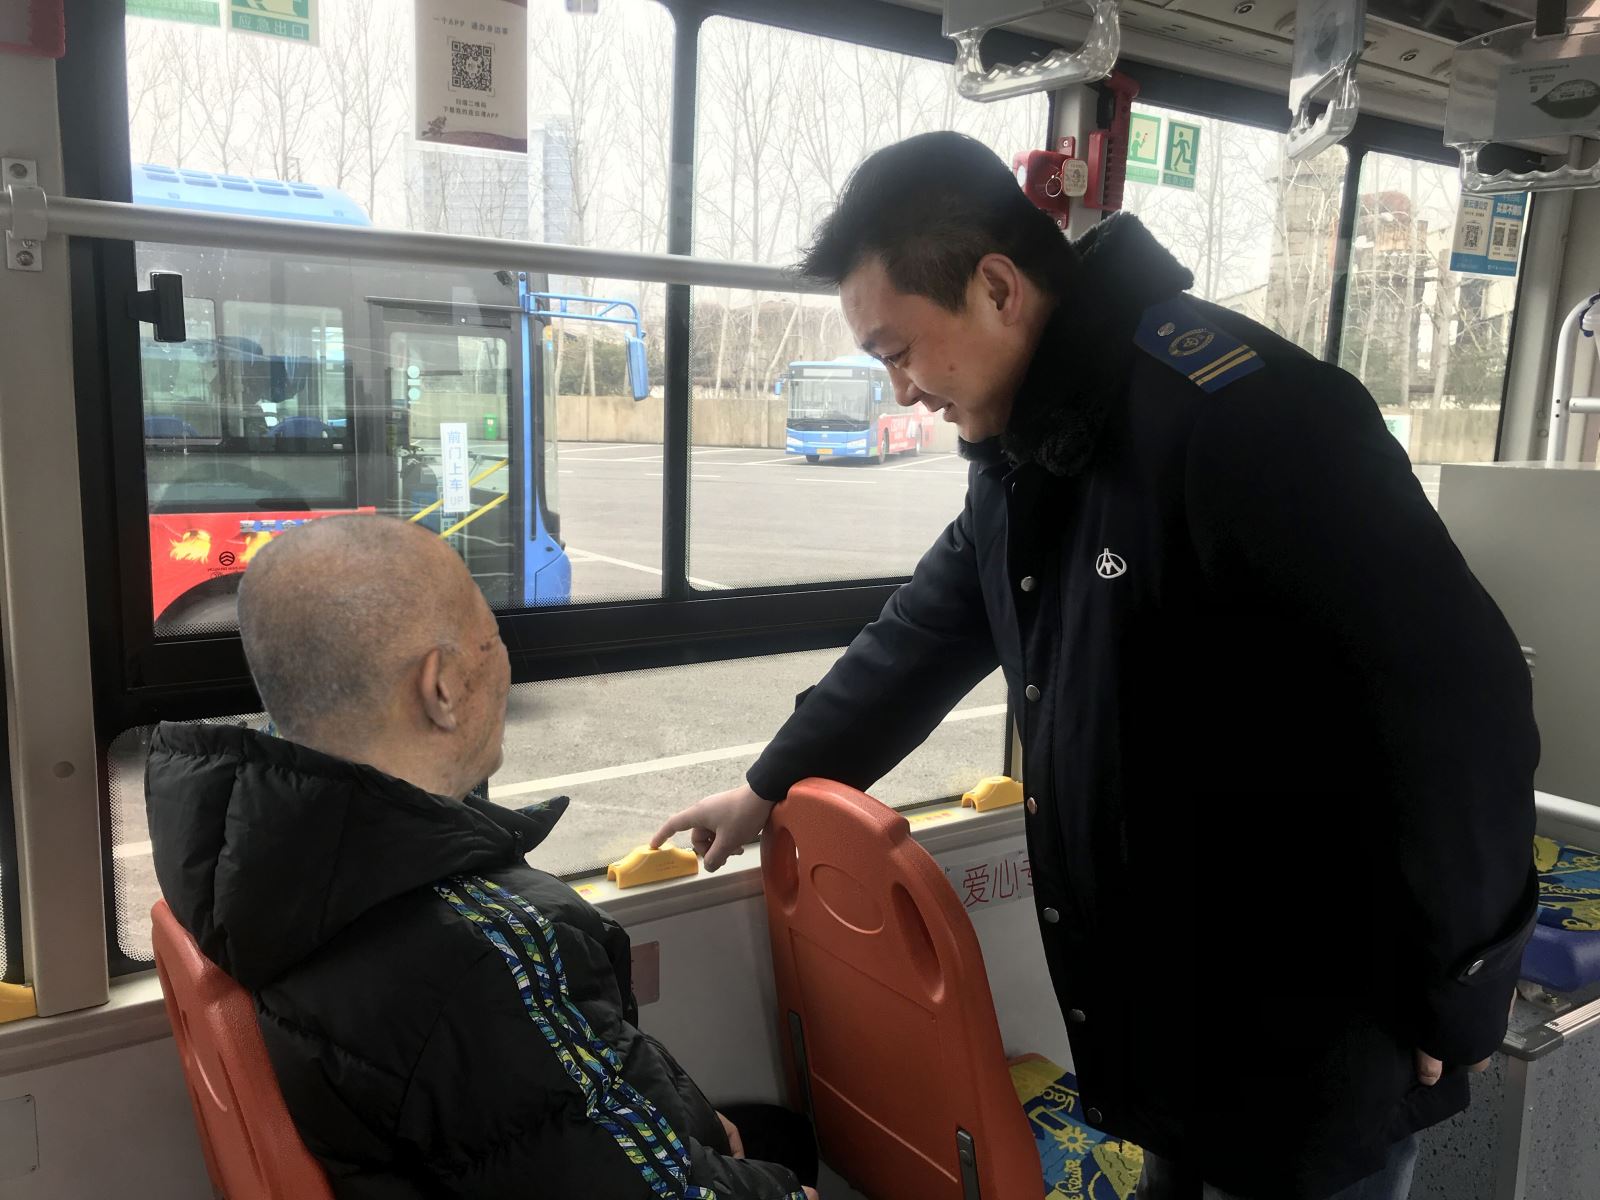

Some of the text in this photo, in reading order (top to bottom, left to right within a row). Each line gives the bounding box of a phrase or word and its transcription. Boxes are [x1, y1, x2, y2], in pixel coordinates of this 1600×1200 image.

[239, 14, 305, 38] 应急出口
[448, 431, 463, 491] 前门上车
